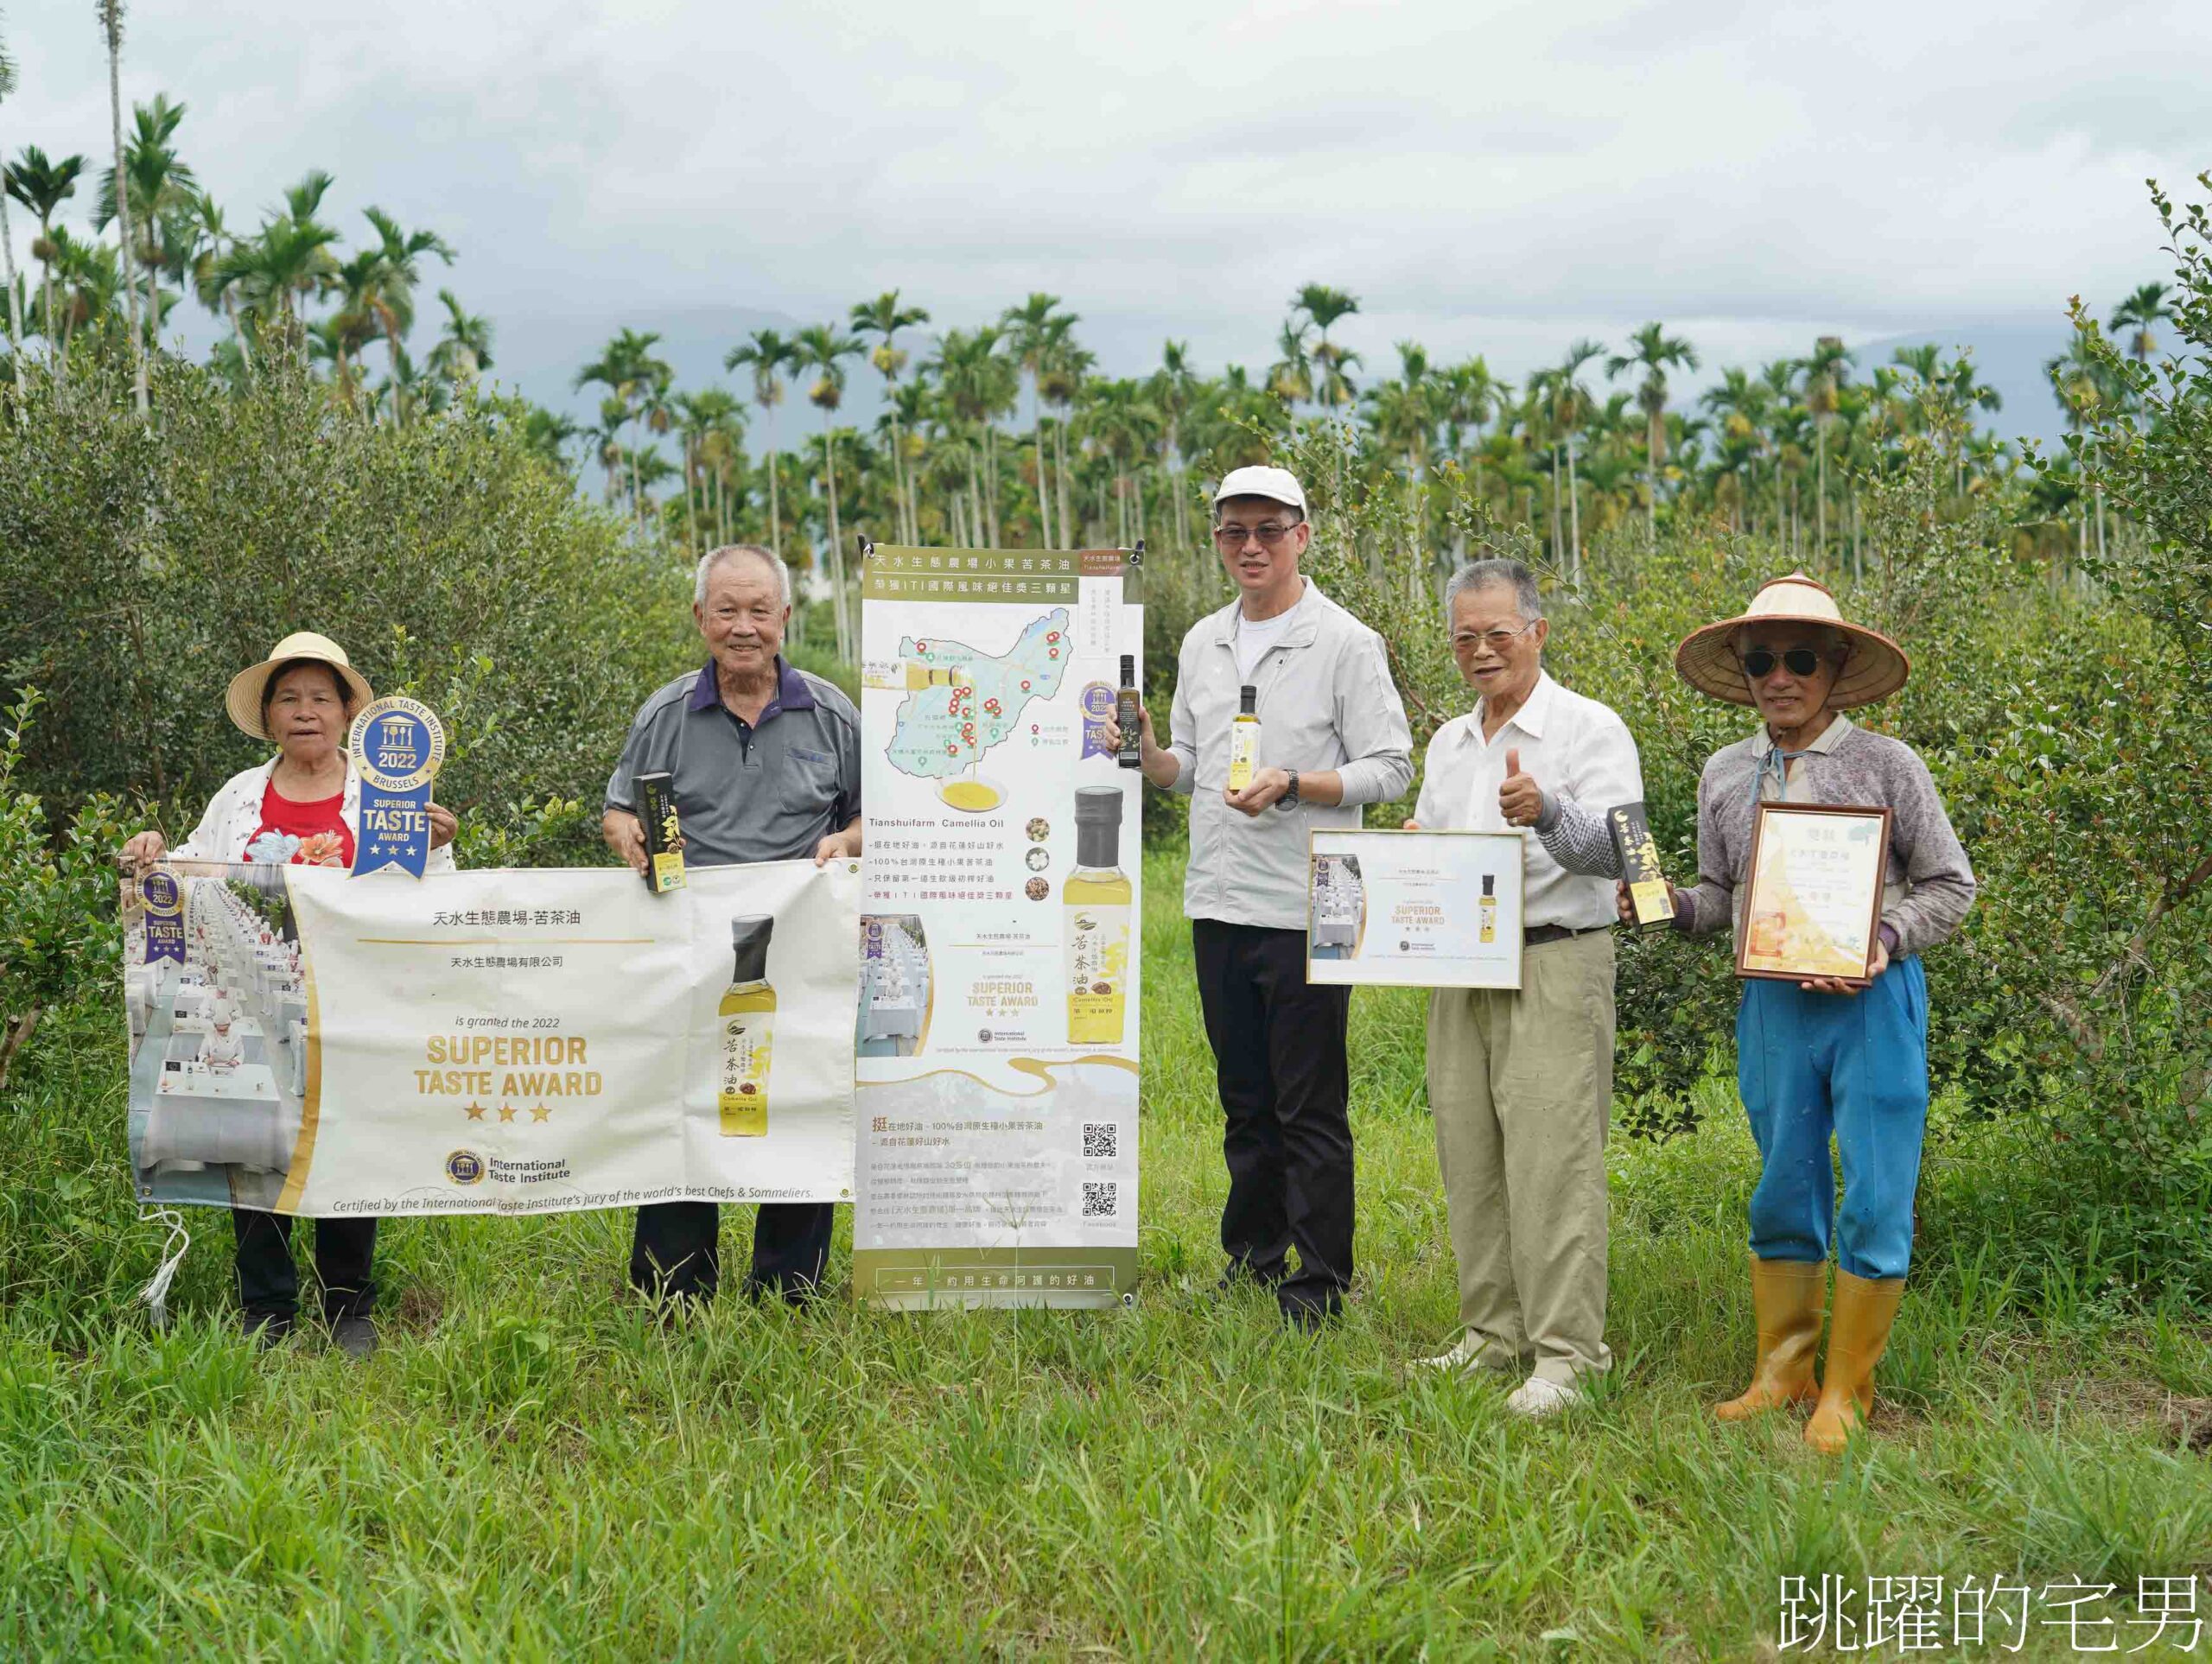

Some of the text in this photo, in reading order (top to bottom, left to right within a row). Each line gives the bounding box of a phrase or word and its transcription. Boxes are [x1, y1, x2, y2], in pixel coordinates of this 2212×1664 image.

[874, 556, 1071, 570] 天水生態農場小果苦茶油
[353, 700, 440, 762] INTERNATIONAL TASTE INSTITUTE
[378, 753, 417, 769] 2022
[372, 775, 420, 789] BRUSSELS
[373, 799, 416, 809] SUPERIOR
[363, 810, 429, 832] TASTE
[869, 818, 935, 828] Tianshuifarm
[942, 818, 986, 828] Camellia
[378, 833, 410, 842] AWARD
[152, 894, 173, 904] 2022
[1395, 906, 1440, 915] SUPERIOR
[1416, 916, 1445, 924] AWARD
[148, 926, 184, 938] TASTE
[451, 956, 563, 969] 天水生態農場有限公司
[1071, 934, 1090, 985] 苦茶油
[972, 981, 1033, 994] SUPERIOR
[967, 996, 1039, 1007] TASTE AWARD
[455, 1016, 560, 1029] is granted the 2022
[427, 1035, 588, 1065] SUPERIOR
[723, 1038, 740, 1085] 苦茶油
[414, 1070, 602, 1096] TASTE AWARD
[490, 1157, 565, 1171] International
[488, 1169, 570, 1183] Taste Institute
[333, 1197, 380, 1211] Certified
[385, 1197, 398, 1213] by
[401, 1198, 419, 1209] the
[423, 1197, 496, 1209] International
[497, 1200, 524, 1210] Taste
[583, 1195, 606, 1206] jury
[609, 1191, 621, 1203] of
[624, 1189, 640, 1201] the
[685, 1185, 706, 1196] best
[708, 1186, 734, 1199] Chefs
[737, 1188, 746, 1197] &
[749, 1187, 814, 1198] Sommeliers.
